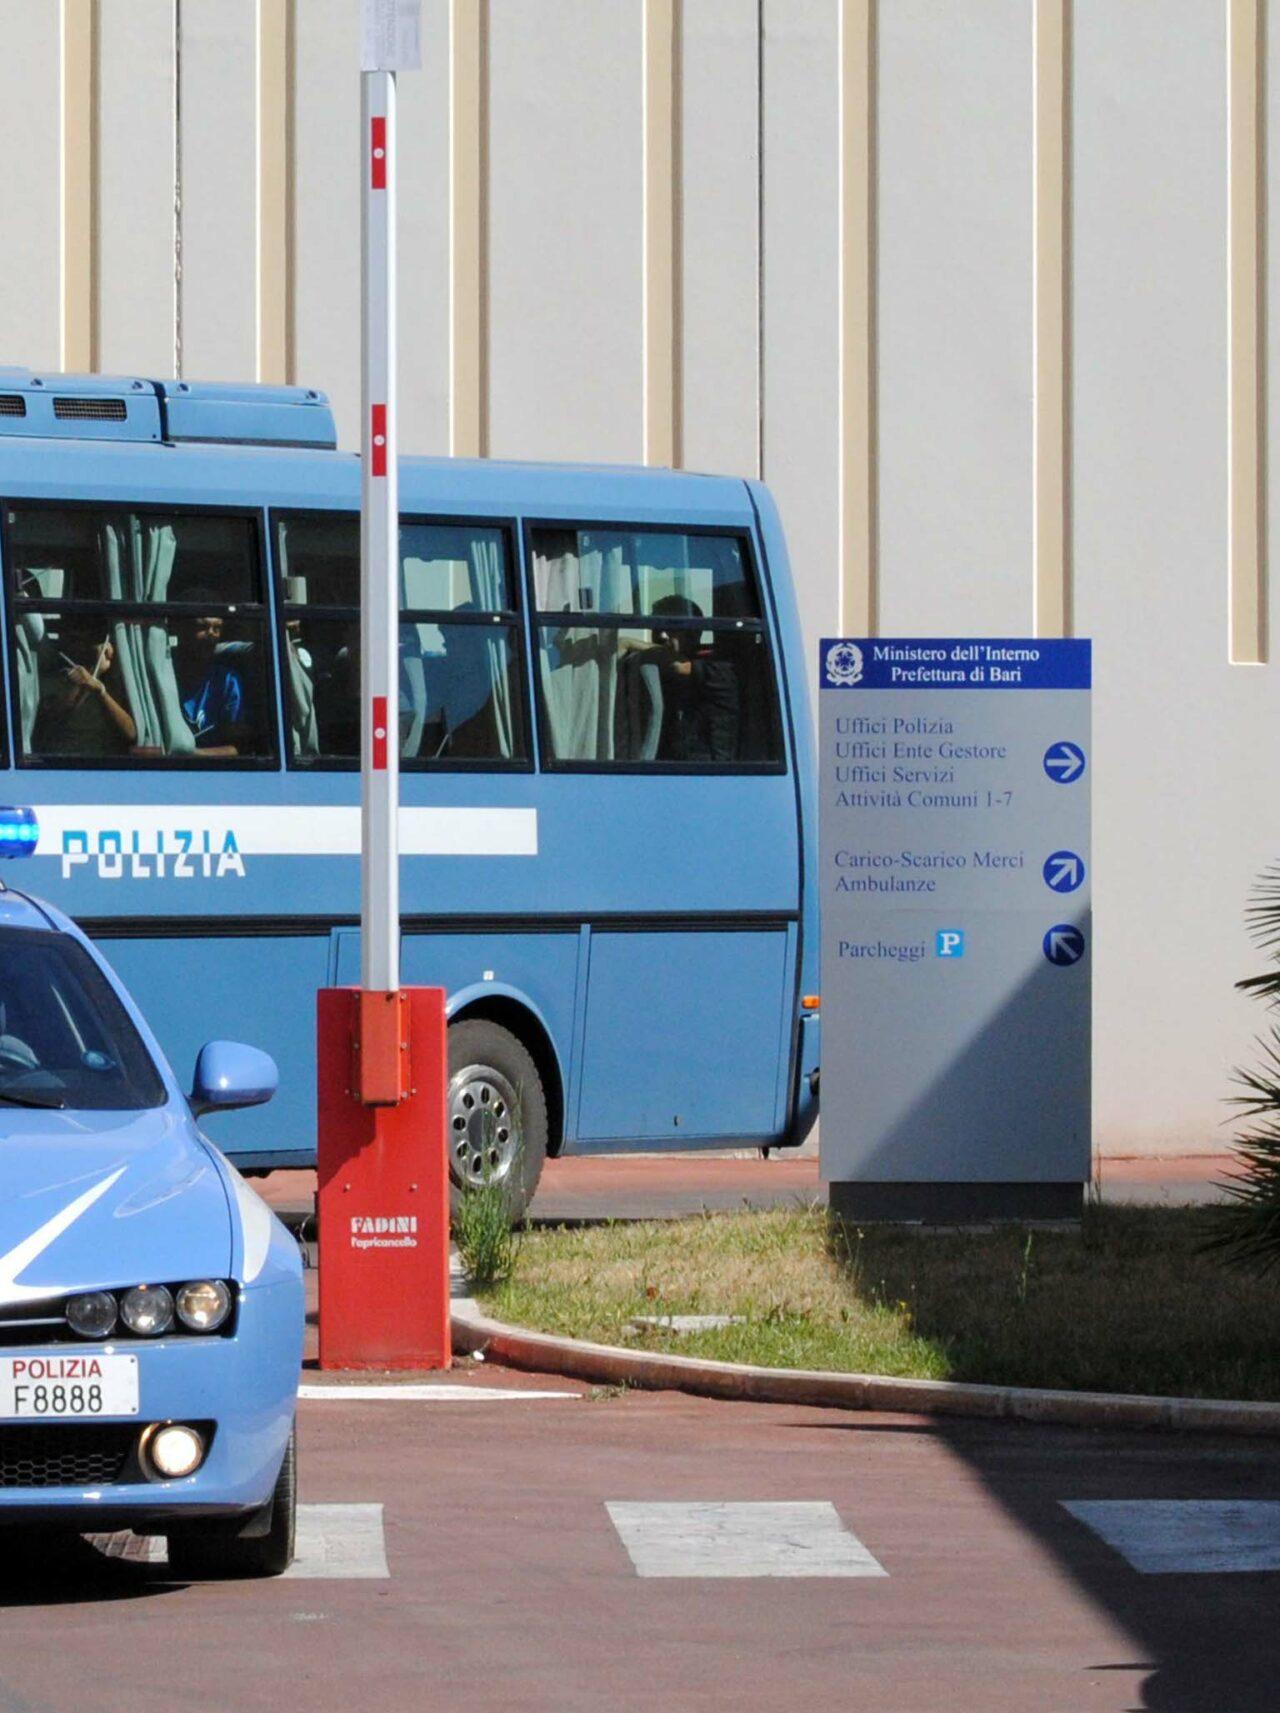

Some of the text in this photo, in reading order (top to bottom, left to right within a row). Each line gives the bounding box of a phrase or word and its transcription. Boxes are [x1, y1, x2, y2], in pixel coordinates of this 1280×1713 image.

[873, 645, 1040, 661] Ministero dell'Interno
[891, 667, 1022, 682] Prefettura di Bari
[835, 717, 954, 734] Uffici Polizia
[835, 742, 1007, 759] Uffici Ente Gestore
[835, 766, 954, 783] Uffici Servizi
[835, 790, 1013, 807] Attività Comuni 1-7
[62, 830, 246, 879] POLIZIA
[834, 851, 1024, 868] Carico-Scarico Merci
[835, 875, 936, 892] Ambulanze
[838, 932, 960, 962] Parcheggi P
[351, 1216, 417, 1233] FADINI
[13, 1359, 103, 1379] POLIZIA
[15, 1384, 103, 1414] F8888
